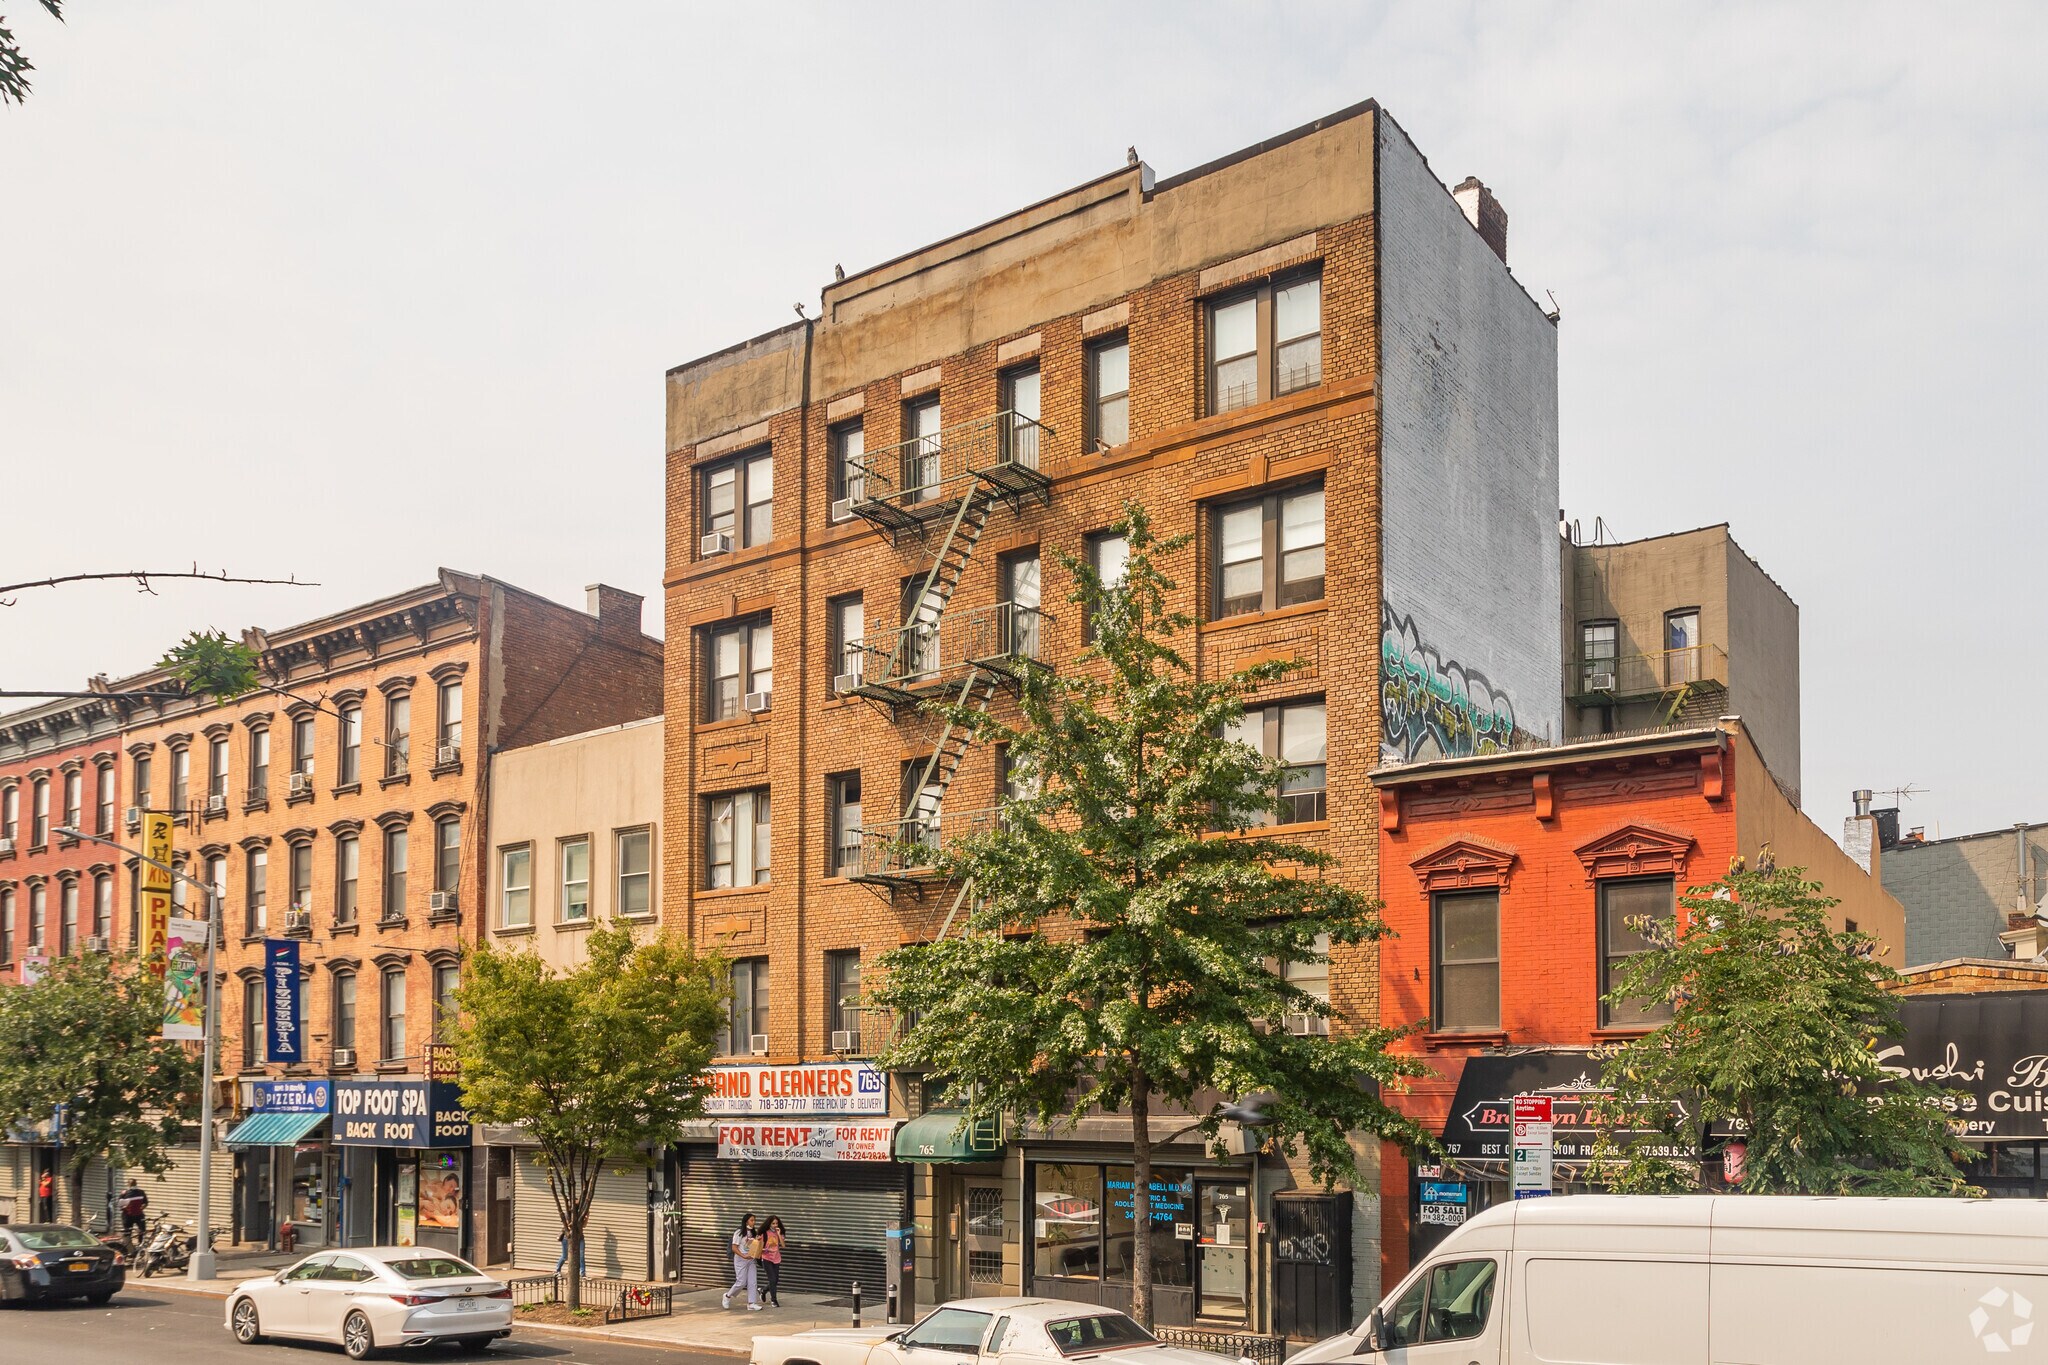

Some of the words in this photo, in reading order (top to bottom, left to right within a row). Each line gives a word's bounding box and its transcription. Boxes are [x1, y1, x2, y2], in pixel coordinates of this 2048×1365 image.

[275, 967, 295, 1053] PIZZERIA
[759, 1070, 853, 1098] CLEANERS
[860, 1072, 880, 1090] 765
[266, 1093, 314, 1104] PIZZERIA
[337, 1089, 360, 1115] TOP
[364, 1089, 398, 1116] FOOT
[402, 1089, 427, 1116] SPA
[759, 1100, 807, 1110] 718-387-7717
[813, 1100, 824, 1109] FREE
[858, 1099, 882, 1109] DELIVERY
[436, 1111, 468, 1122] BACK
[346, 1122, 376, 1138] BACK
[384, 1123, 414, 1140] FOOT
[436, 1125, 468, 1136] FOOT
[818, 1128, 828, 1138] By
[836, 1128, 856, 1140] FOR
[860, 1128, 890, 1141] RENT
[719, 1127, 756, 1146] FOR
[761, 1127, 812, 1146] RENT
[810, 1138, 834, 1148] Owner
[753, 1149, 782, 1158] Business
[784, 1150, 804, 1158] Since
[806, 1150, 821, 1158] 1969
[920, 1145, 934, 1154] 765
[1447, 1144, 1461, 1154] 767
[1482, 1144, 1500, 1154] BEST
[1516, 1150, 1524, 1160] 2
[1107, 1181, 1130, 1190] MARIAM
[1424, 1206, 1440, 1214] FOR
[1443, 1206, 1464, 1214] SALE
[1432, 1214, 1464, 1222] 382-0001
[905, 1238, 911, 1250] P
